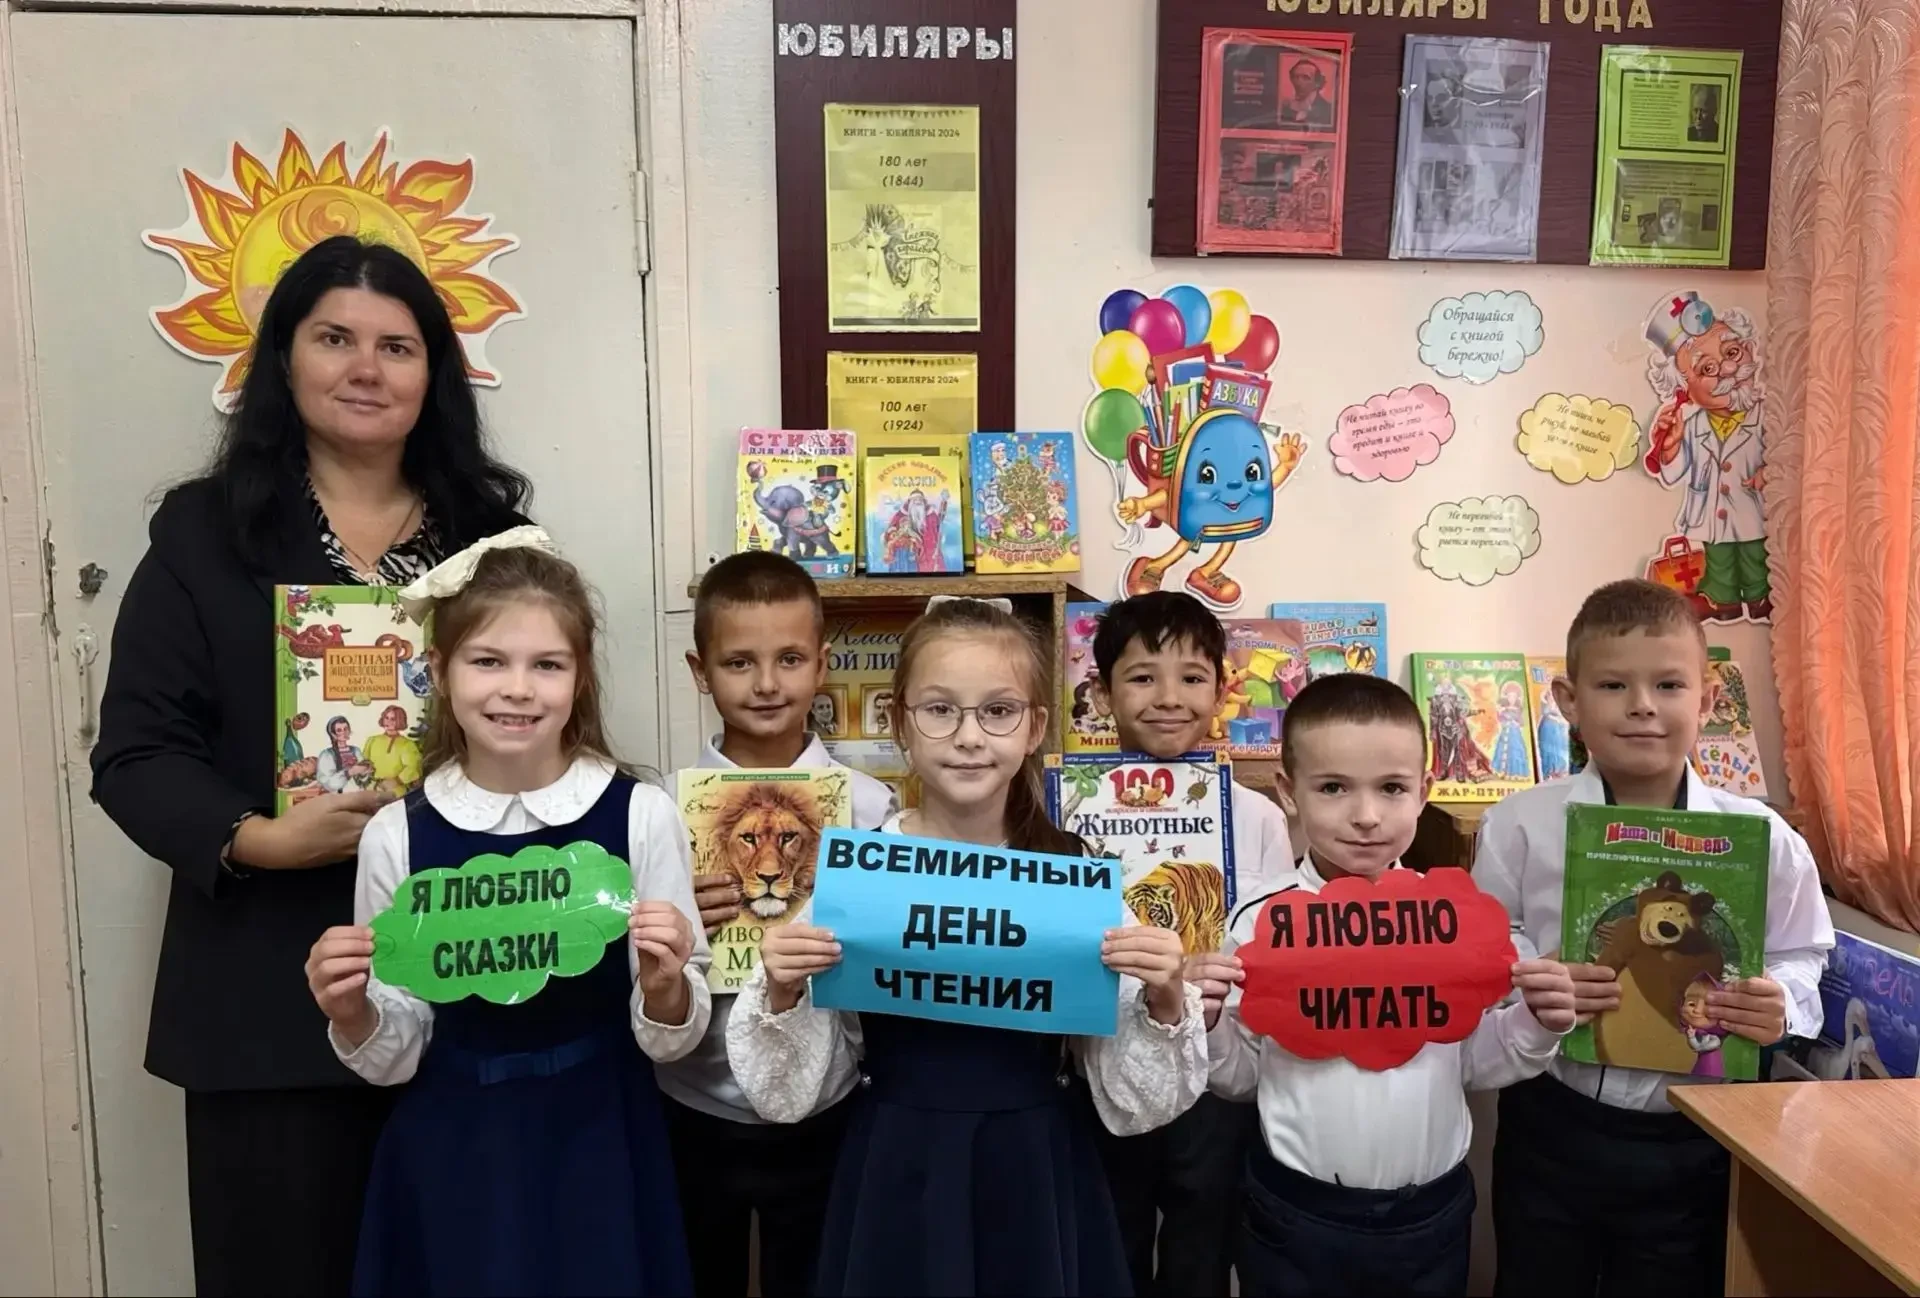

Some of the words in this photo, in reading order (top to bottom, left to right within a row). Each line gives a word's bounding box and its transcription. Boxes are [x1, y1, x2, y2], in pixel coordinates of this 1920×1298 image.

[778, 23, 1013, 60] ЮБИЛЯРЫ
[843, 128, 877, 137] КНИГИ
[886, 128, 935, 138] ЮБИЛЯРЫ
[938, 129, 960, 138] 2024
[880, 156, 901, 167] 180
[905, 158, 928, 167] лет
[882, 175, 924, 187] (1844)
[1442, 306, 1515, 325] Обращайся
[1450, 331, 1458, 341] с
[1461, 330, 1504, 344] книгой
[1447, 346, 1504, 365] бережно!
[845, 375, 878, 385] КНИГИ
[886, 375, 935, 385] ЮБИЛЯРЫ
[937, 375, 960, 384] 2024
[880, 401, 902, 412] 100
[904, 403, 928, 412] лет
[1212, 381, 1259, 408] АЗБУКА
[882, 420, 924, 432] (1924)
[781, 446, 847, 456] МЛШЕЙ
[330, 655, 393, 665] ПОЛНАЯ
[1109, 768, 1174, 801] 100
[1073, 812, 1214, 836] Животные
[1604, 821, 1650, 845] Маша
[1661, 827, 1733, 856] Медведь
[826, 838, 1112, 890] ВСЕМИРНЫЙ
[409, 880, 431, 915] Я
[441, 867, 572, 912] ЛЮБЛЮ
[902, 903, 1028, 951] ДЕНЬ
[1270, 904, 1294, 948] Я
[1306, 898, 1458, 948] ЛЮБЛЮ
[433, 931, 560, 979] СКАЗКИ
[725, 946, 754, 970] М
[874, 967, 1053, 1013] ЧТЕНИЯ
[1300, 985, 1450, 1030] ЧИТАТЬ
